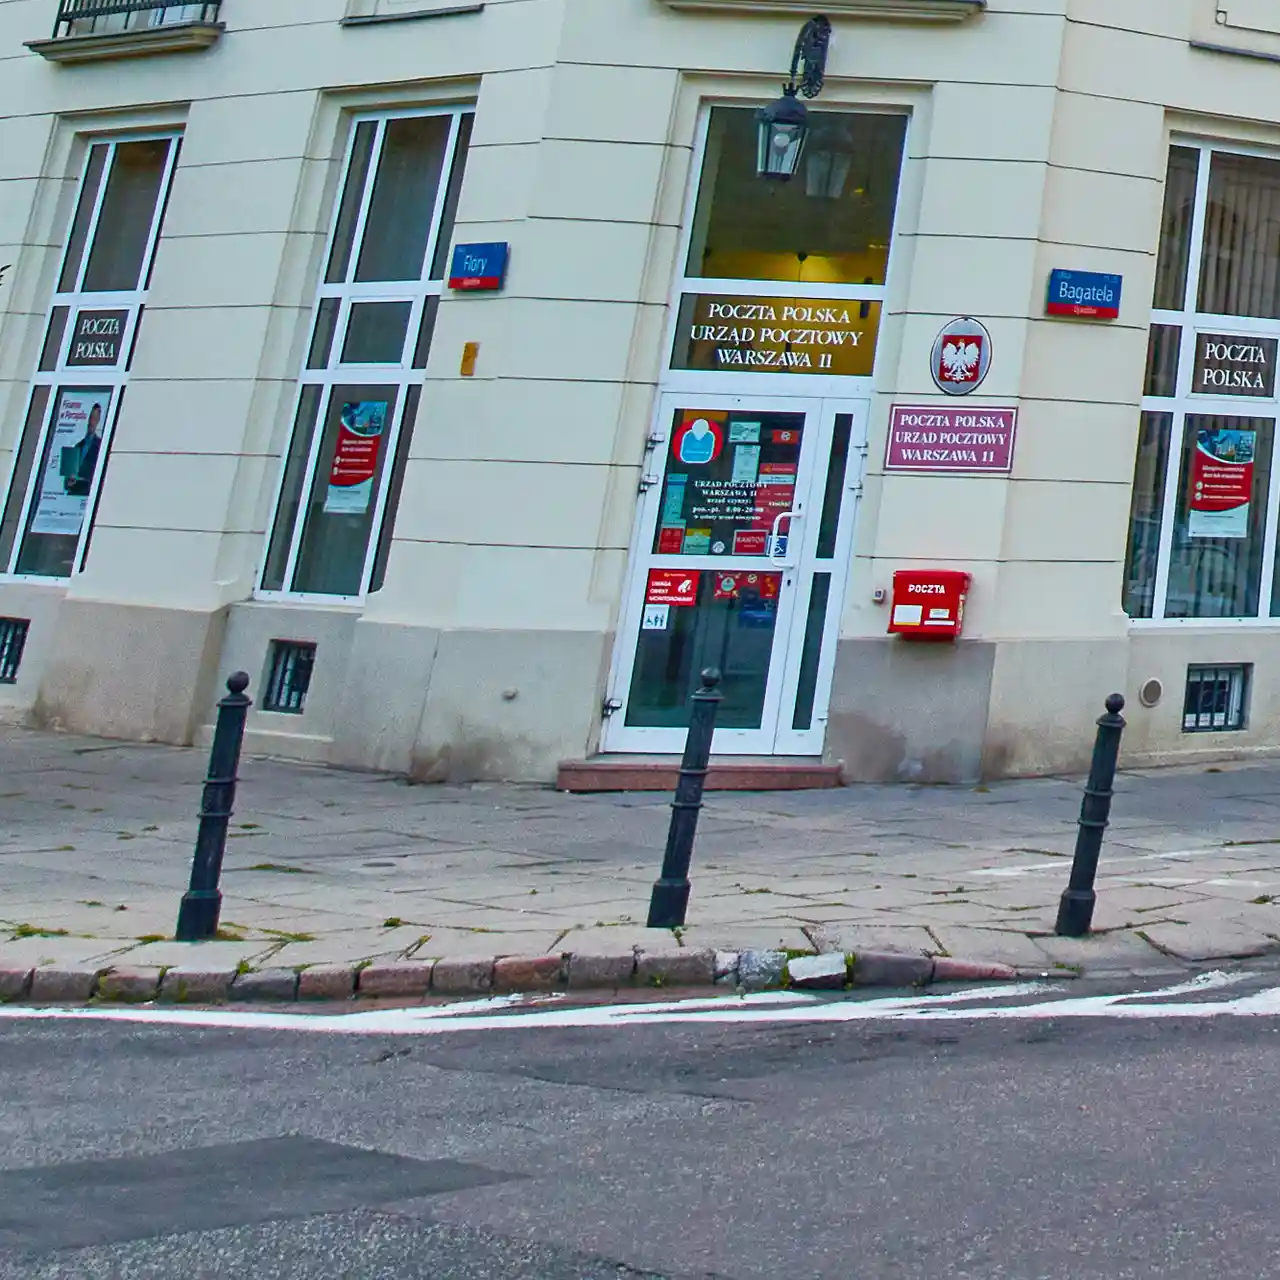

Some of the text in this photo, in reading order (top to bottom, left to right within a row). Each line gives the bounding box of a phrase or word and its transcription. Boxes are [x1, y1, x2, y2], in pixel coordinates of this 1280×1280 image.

[1059, 281, 1113, 304] Bagatela
[708, 303, 851, 324] POCZTA POLSKA
[80, 318, 119, 335] POCZTA
[690, 325, 863, 347] URZĄD POCZTOWY
[74, 342, 114, 359] POLSKA
[717, 348, 832, 368] WARSZAWA 11
[1204, 342, 1267, 364] POCZTA
[1202, 368, 1264, 389] POLSKA
[900, 414, 1005, 429] POCZTA POLSKA
[895, 431, 1007, 446] URZĄD POCZTOWY
[901, 448, 995, 462] WARSZAWA 11
[702, 489, 748, 497] WARSZAWA
[908, 584, 945, 594] POCZTA
